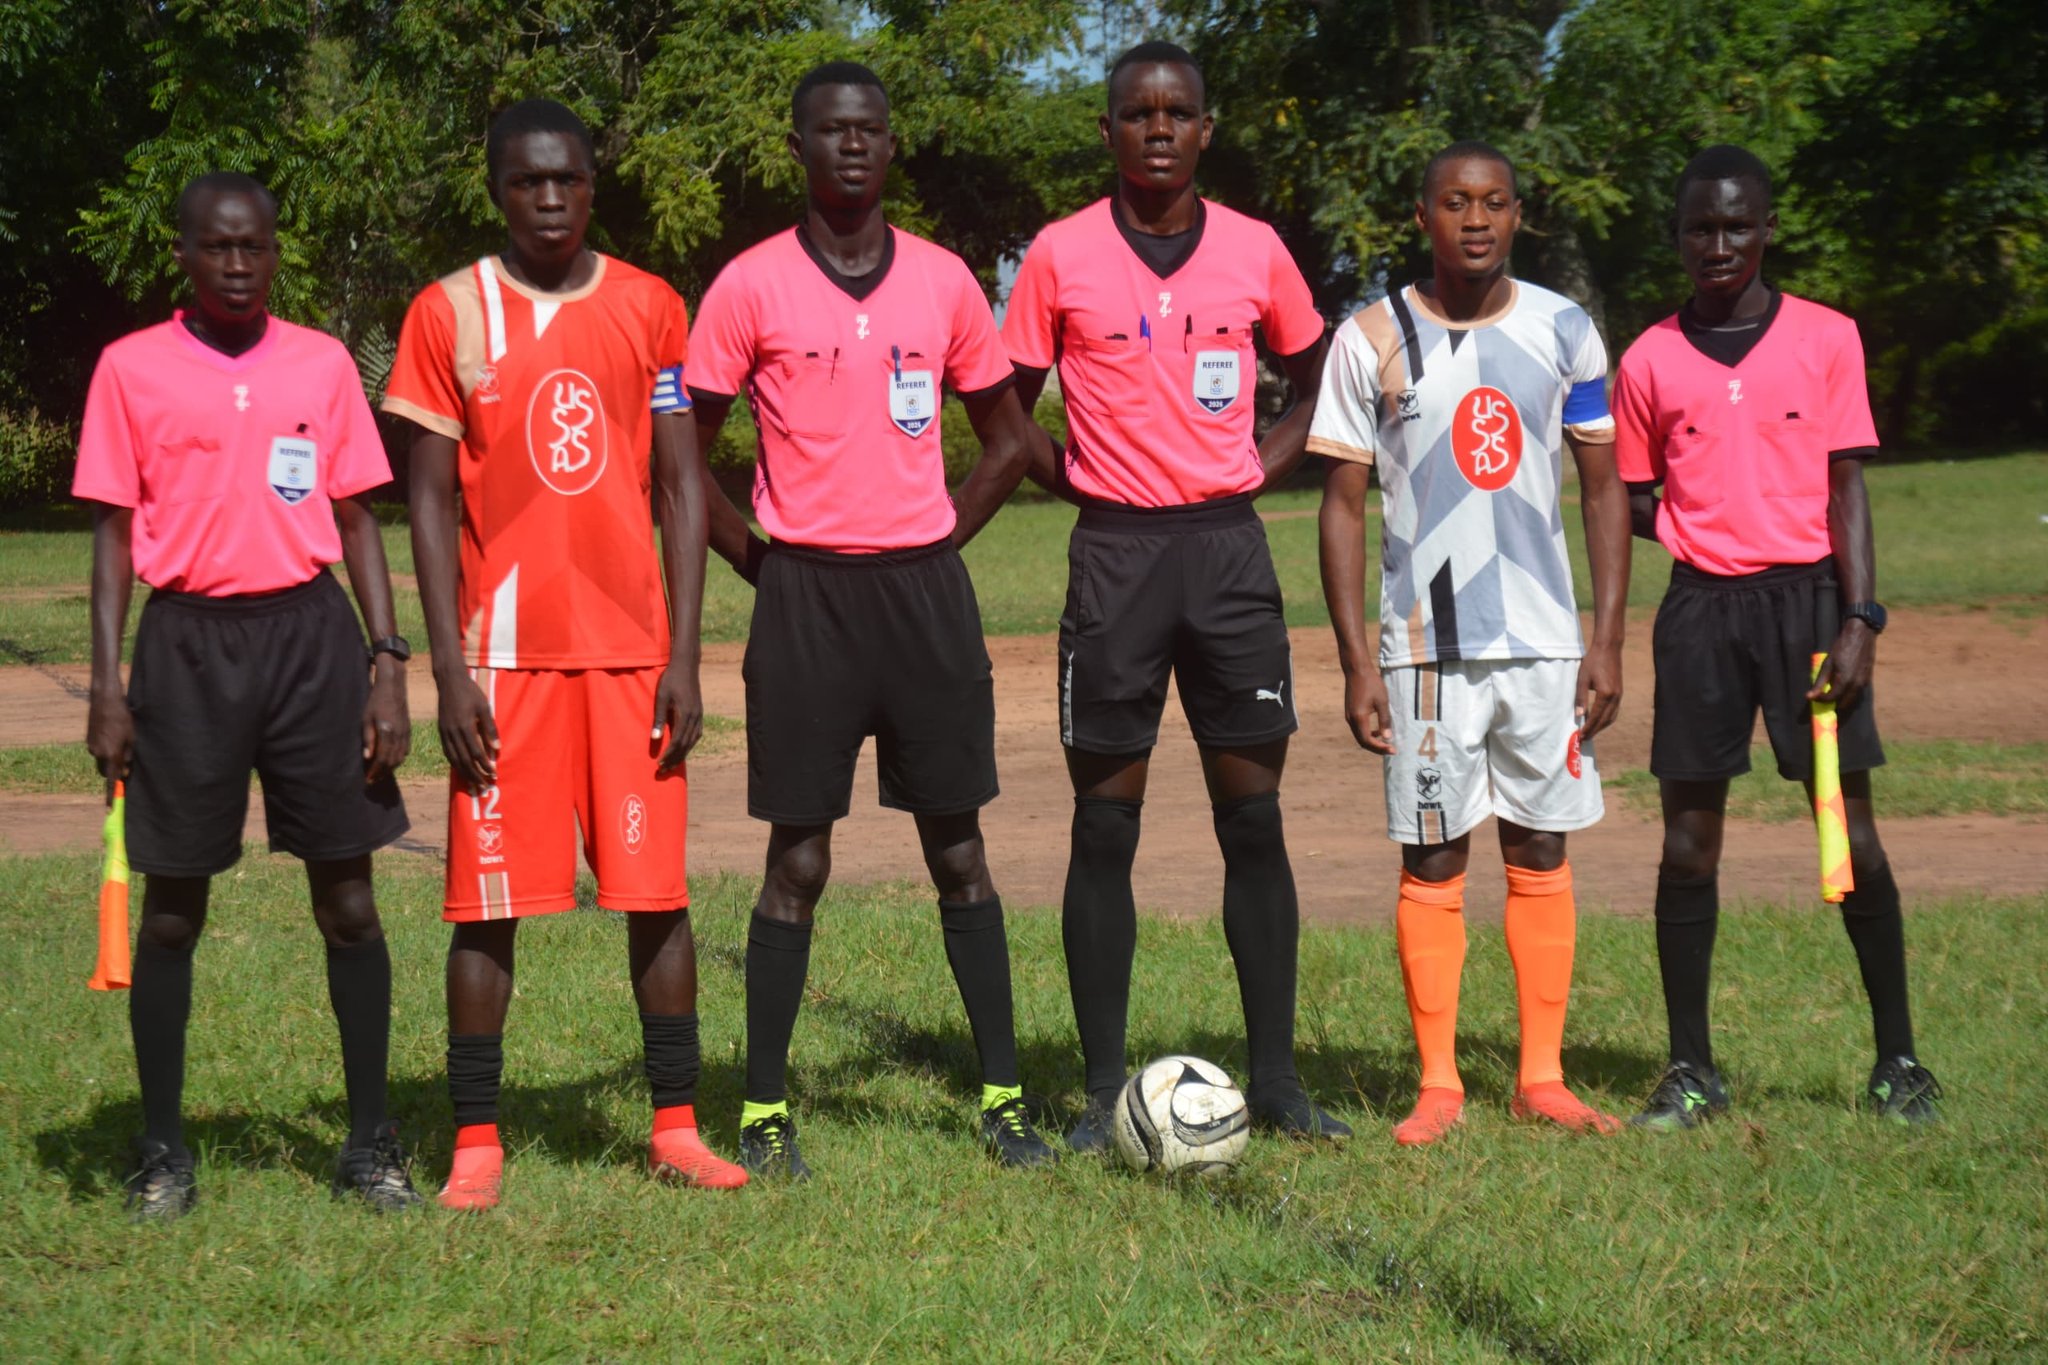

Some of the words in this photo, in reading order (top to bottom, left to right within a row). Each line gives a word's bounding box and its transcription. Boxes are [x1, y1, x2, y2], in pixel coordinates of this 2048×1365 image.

[1202, 361, 1233, 369] REFEREE
[896, 381, 927, 390] REFEREE
[1418, 727, 1439, 763] 4
[472, 784, 502, 821] 12
[1417, 801, 1443, 810] hawk
